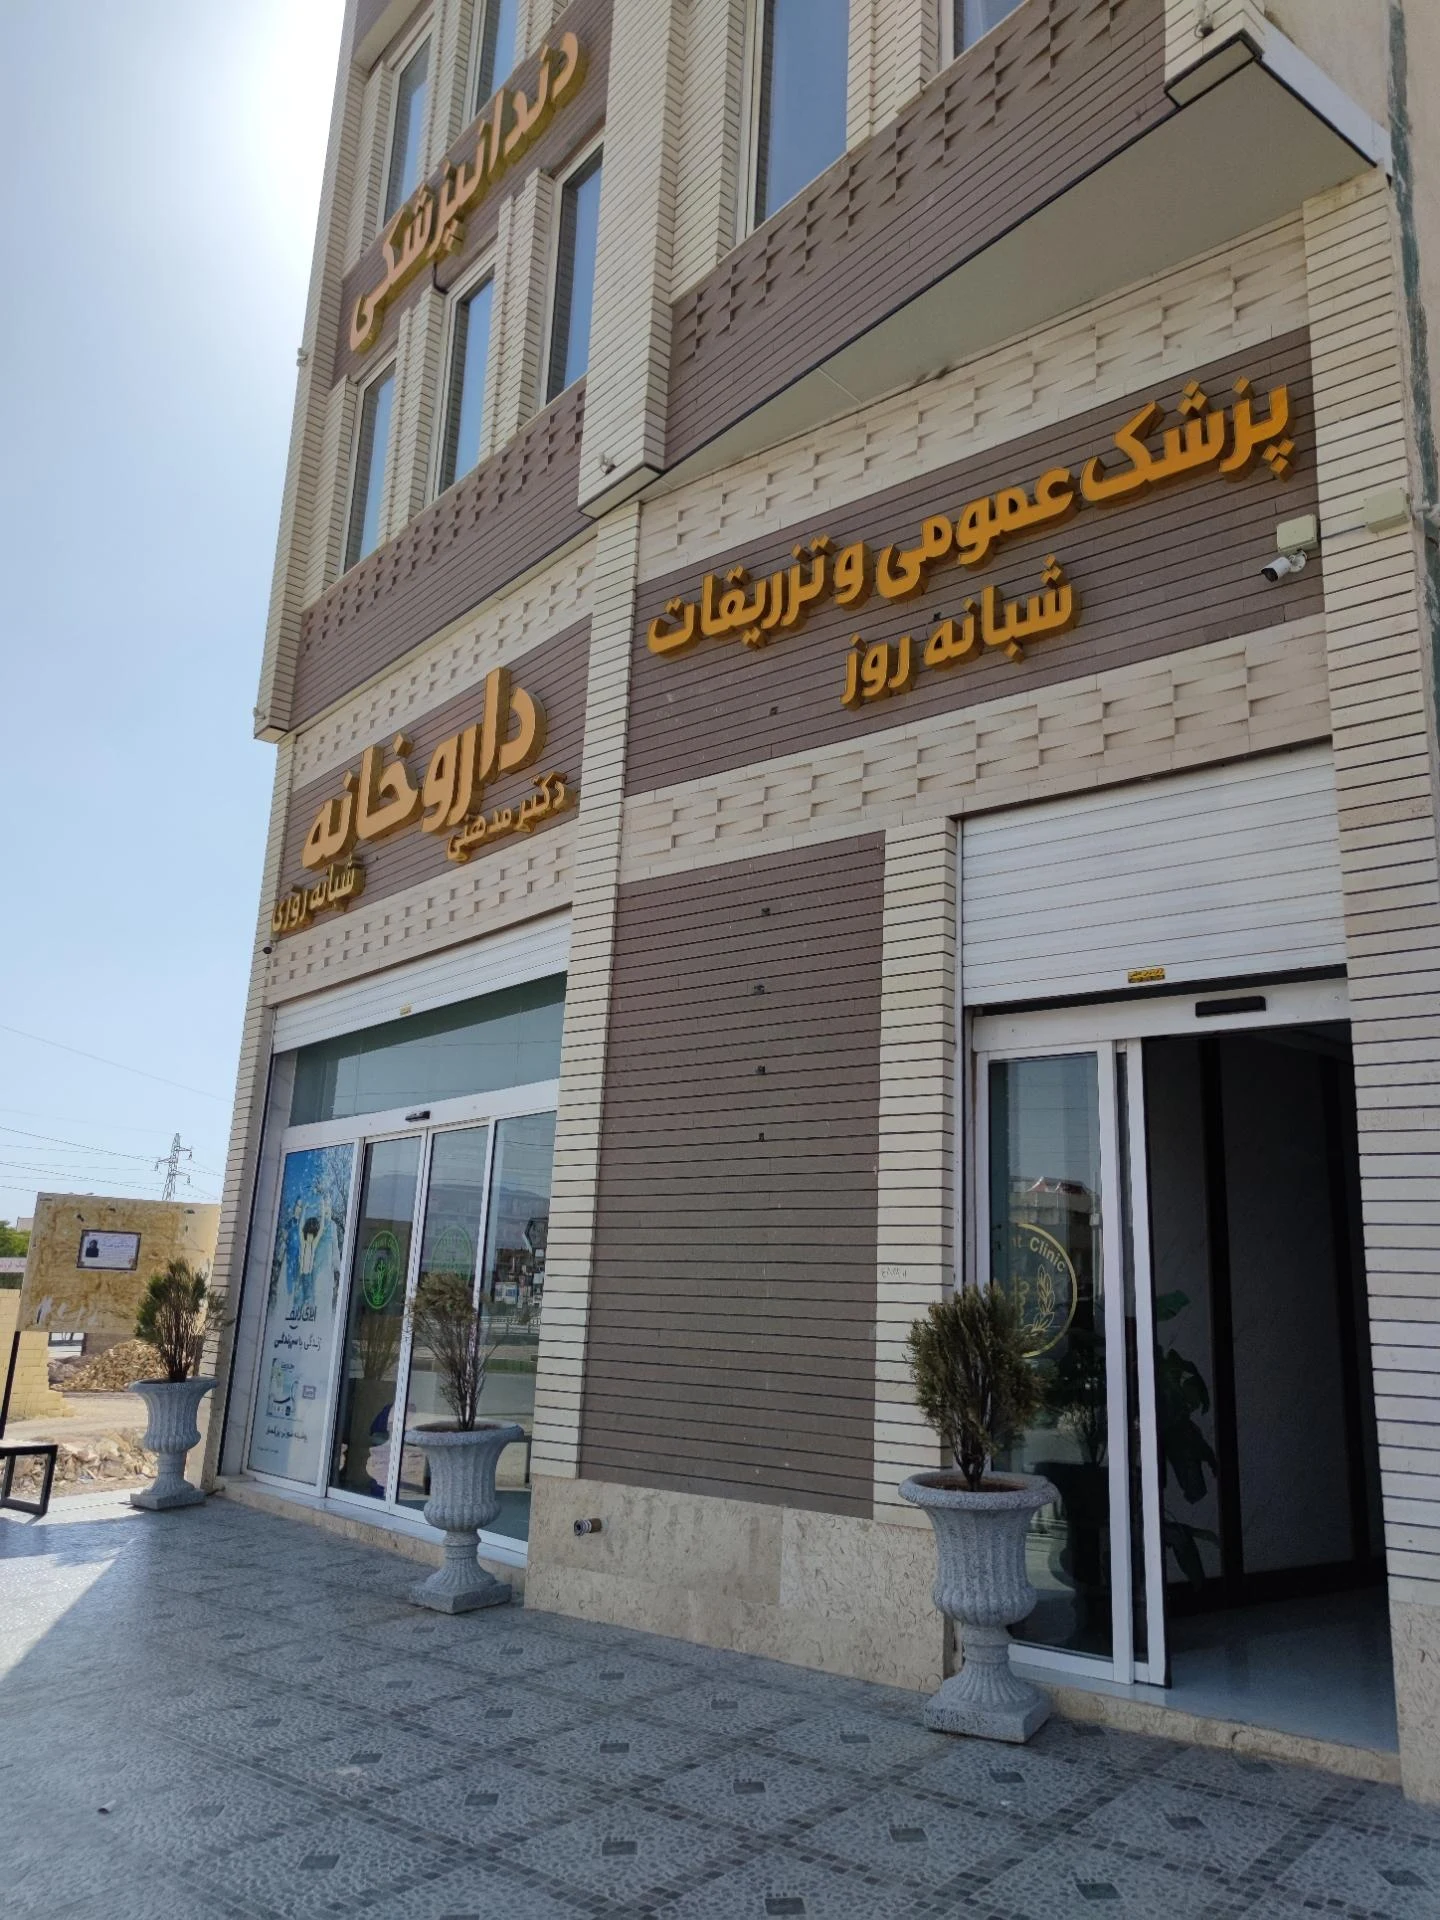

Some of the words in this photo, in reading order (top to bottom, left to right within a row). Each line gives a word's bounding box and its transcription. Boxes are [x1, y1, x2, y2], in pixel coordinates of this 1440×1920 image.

[350, 31, 584, 352] دندانپزشکی
[1080, 376, 1293, 501] پزشک
[833, 541, 868, 606] و
[876, 466, 1077, 599] عمومی
[647, 533, 829, 656] تزریقات
[923, 553, 1075, 669] شبانه
[840, 633, 913, 707] روز
[302, 667, 543, 868] داروخانه
[514, 771, 570, 832] دکتر
[308, 852, 361, 911] شبانه
[1029, 1236, 1066, 1273] Clinic
